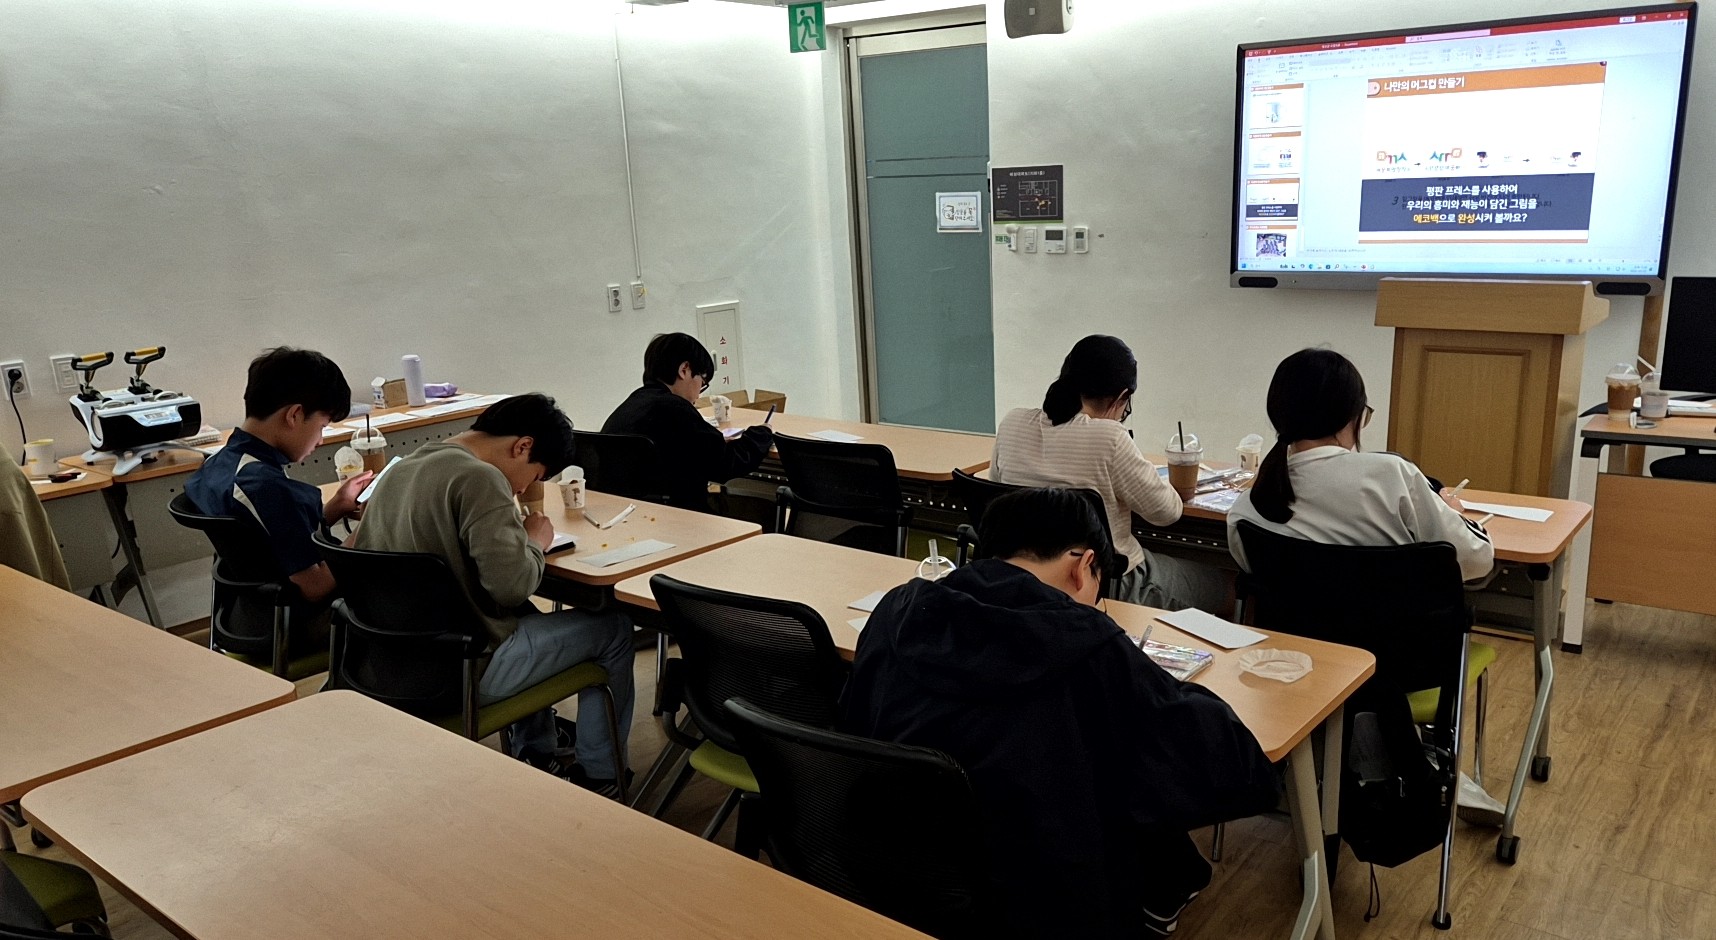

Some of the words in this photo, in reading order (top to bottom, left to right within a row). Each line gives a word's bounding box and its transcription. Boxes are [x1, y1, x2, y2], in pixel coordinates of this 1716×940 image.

[1384, 80, 1410, 92] 나만의
[1411, 78, 1437, 90] 머그컵
[1438, 75, 1465, 89] 만들기
[1445, 185, 1480, 196] 프레스를
[1482, 184, 1518, 196] 사용하여
[1406, 200, 1432, 211] 우리의
[1433, 199, 1460, 211] 흥미와
[1461, 199, 1488, 209] 재능이
[1489, 199, 1508, 209] 담긴
[1509, 198, 1538, 209] 그림을
[1494, 213, 1528, 224] 볼까요?
[720, 336, 730, 385] 소화기
